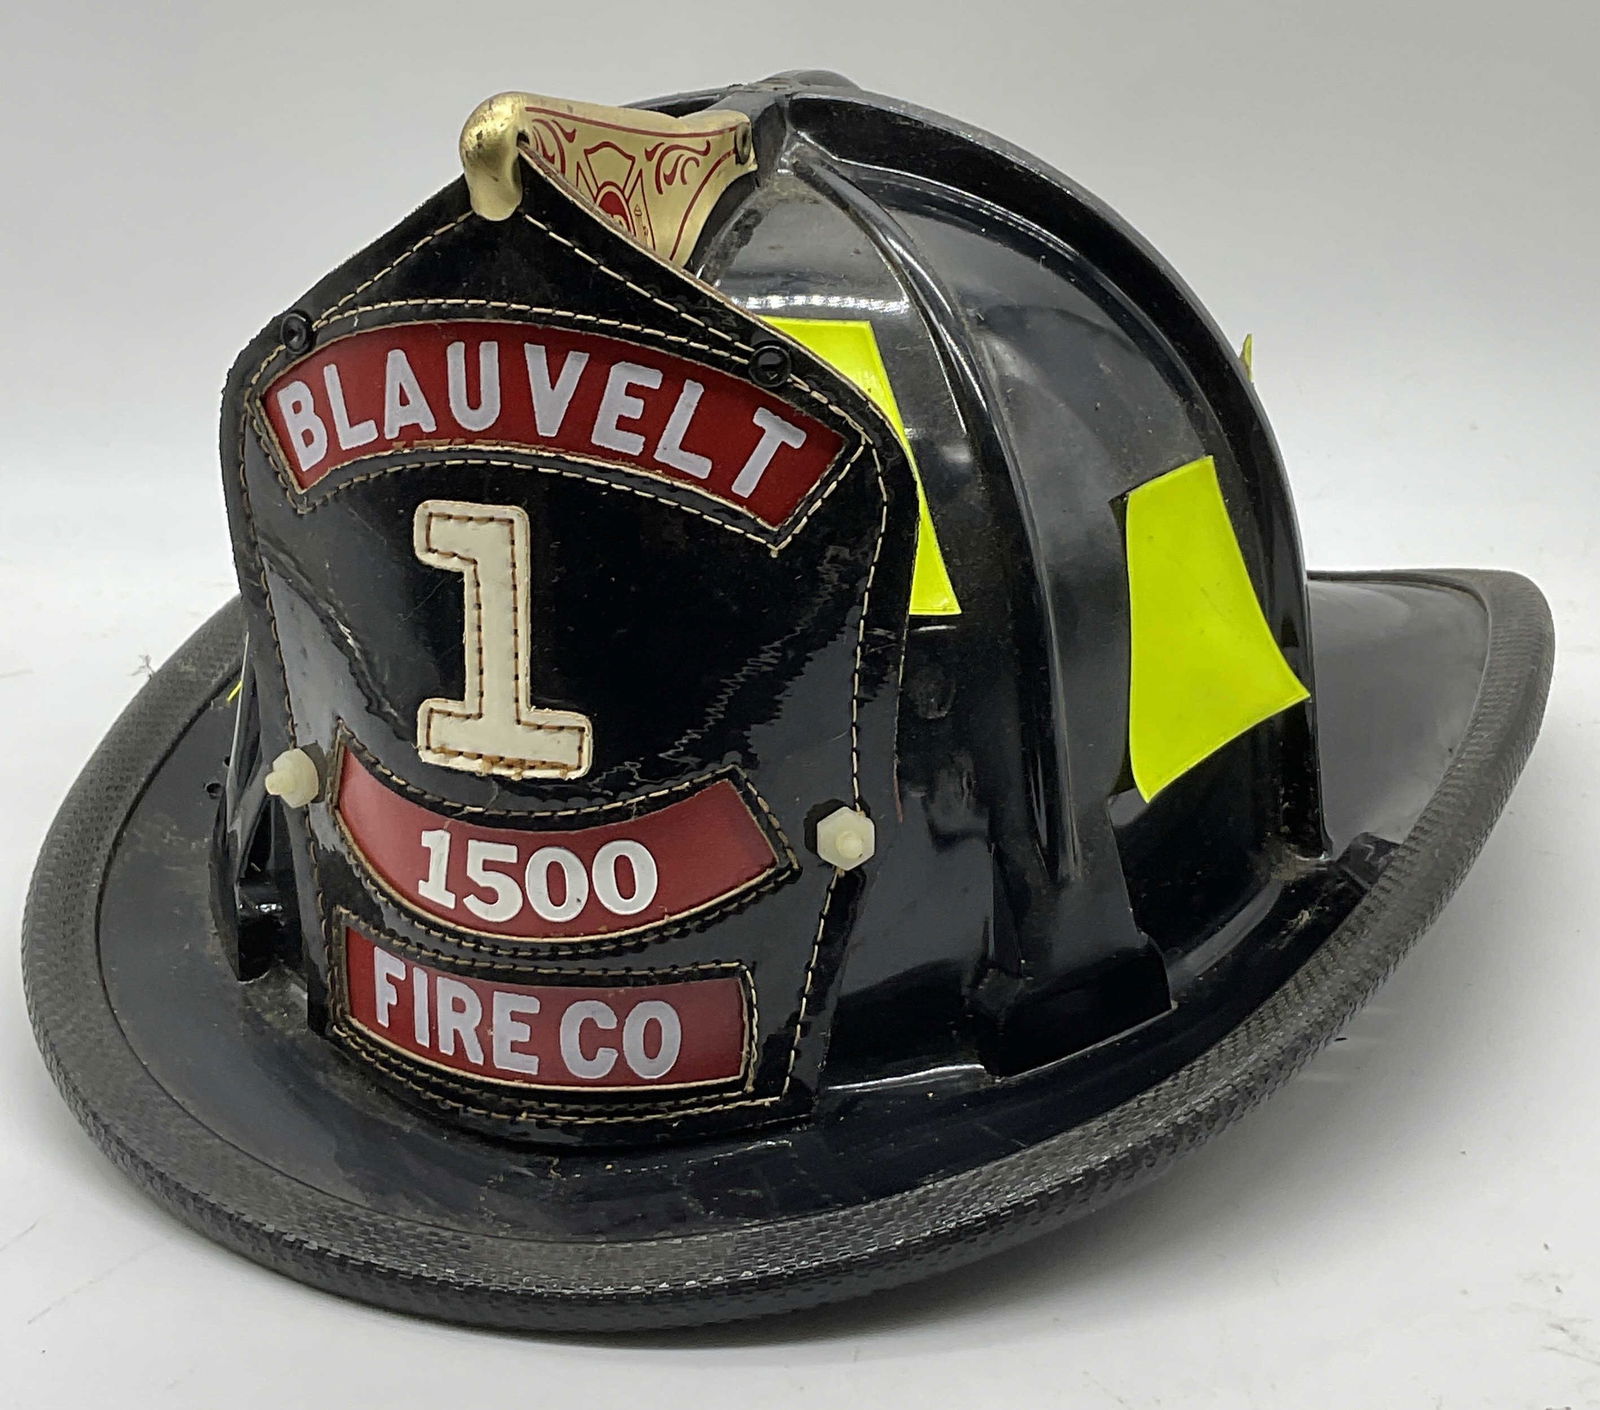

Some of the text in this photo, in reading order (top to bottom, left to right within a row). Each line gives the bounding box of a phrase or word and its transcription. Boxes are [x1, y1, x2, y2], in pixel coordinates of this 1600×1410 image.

[276, 341, 807, 499] BLAUVELT
[412, 499, 593, 780] 1
[417, 829, 659, 922] 1500
[373, 946, 682, 1080] FIRE CO
